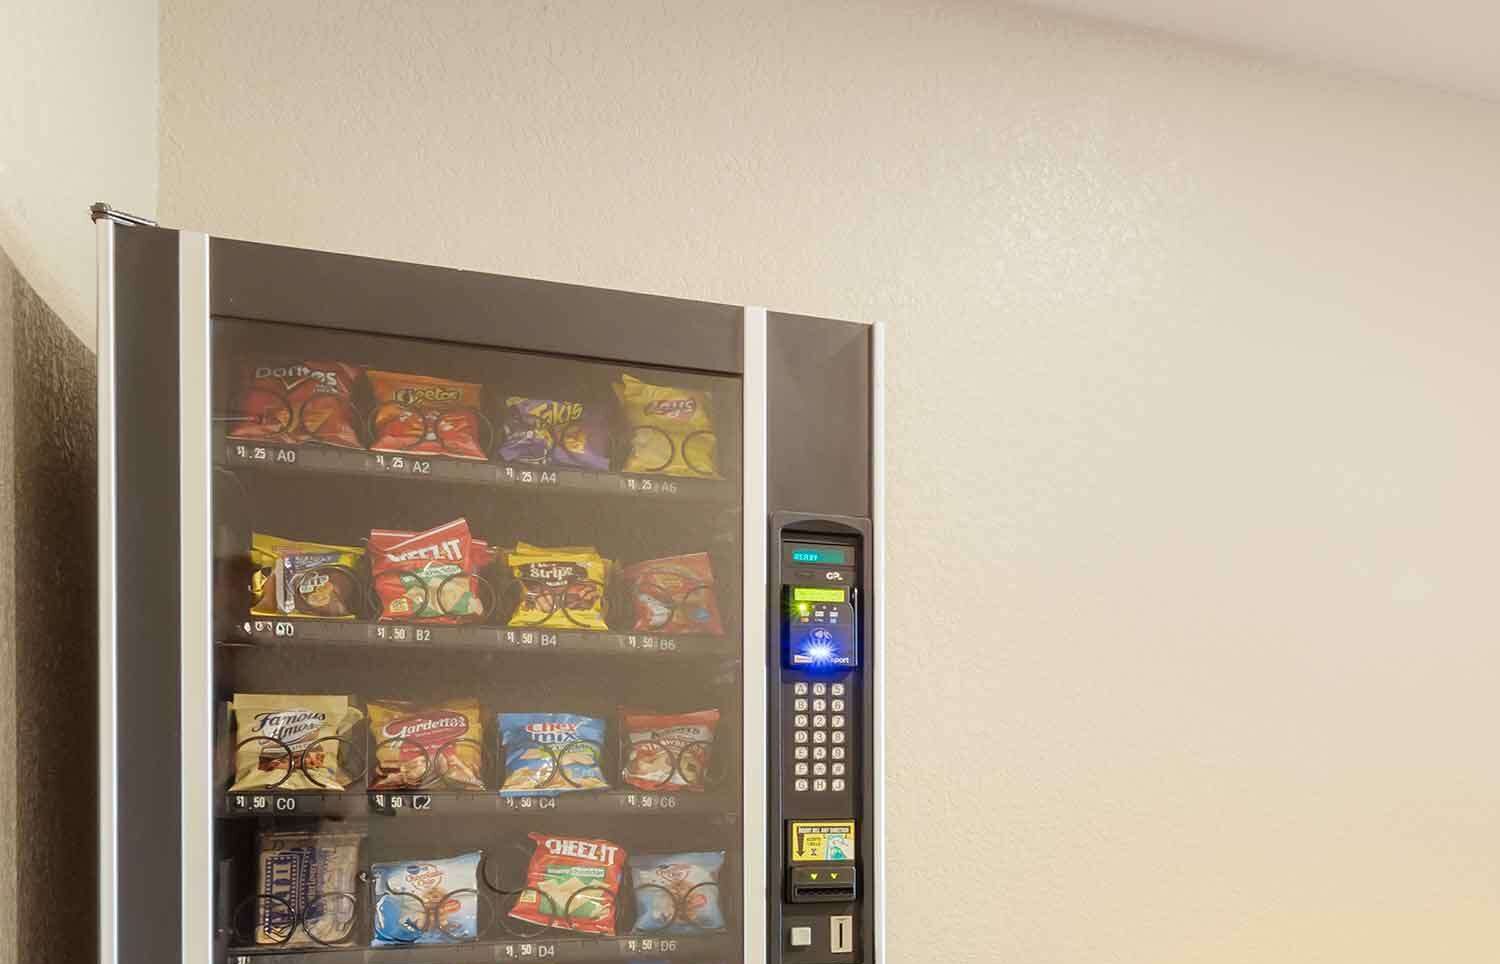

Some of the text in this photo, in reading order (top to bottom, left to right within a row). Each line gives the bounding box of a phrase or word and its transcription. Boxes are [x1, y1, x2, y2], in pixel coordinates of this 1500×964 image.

[277, 449, 296, 463] A0
[412, 461, 431, 474] A2
[540, 472, 557, 484] A4
[416, 630, 431, 641] B2
[541, 634, 557, 646] B4
[251, 710, 326, 733] Famous
[276, 799, 295, 811] C0
[538, 945, 555, 958] D4
